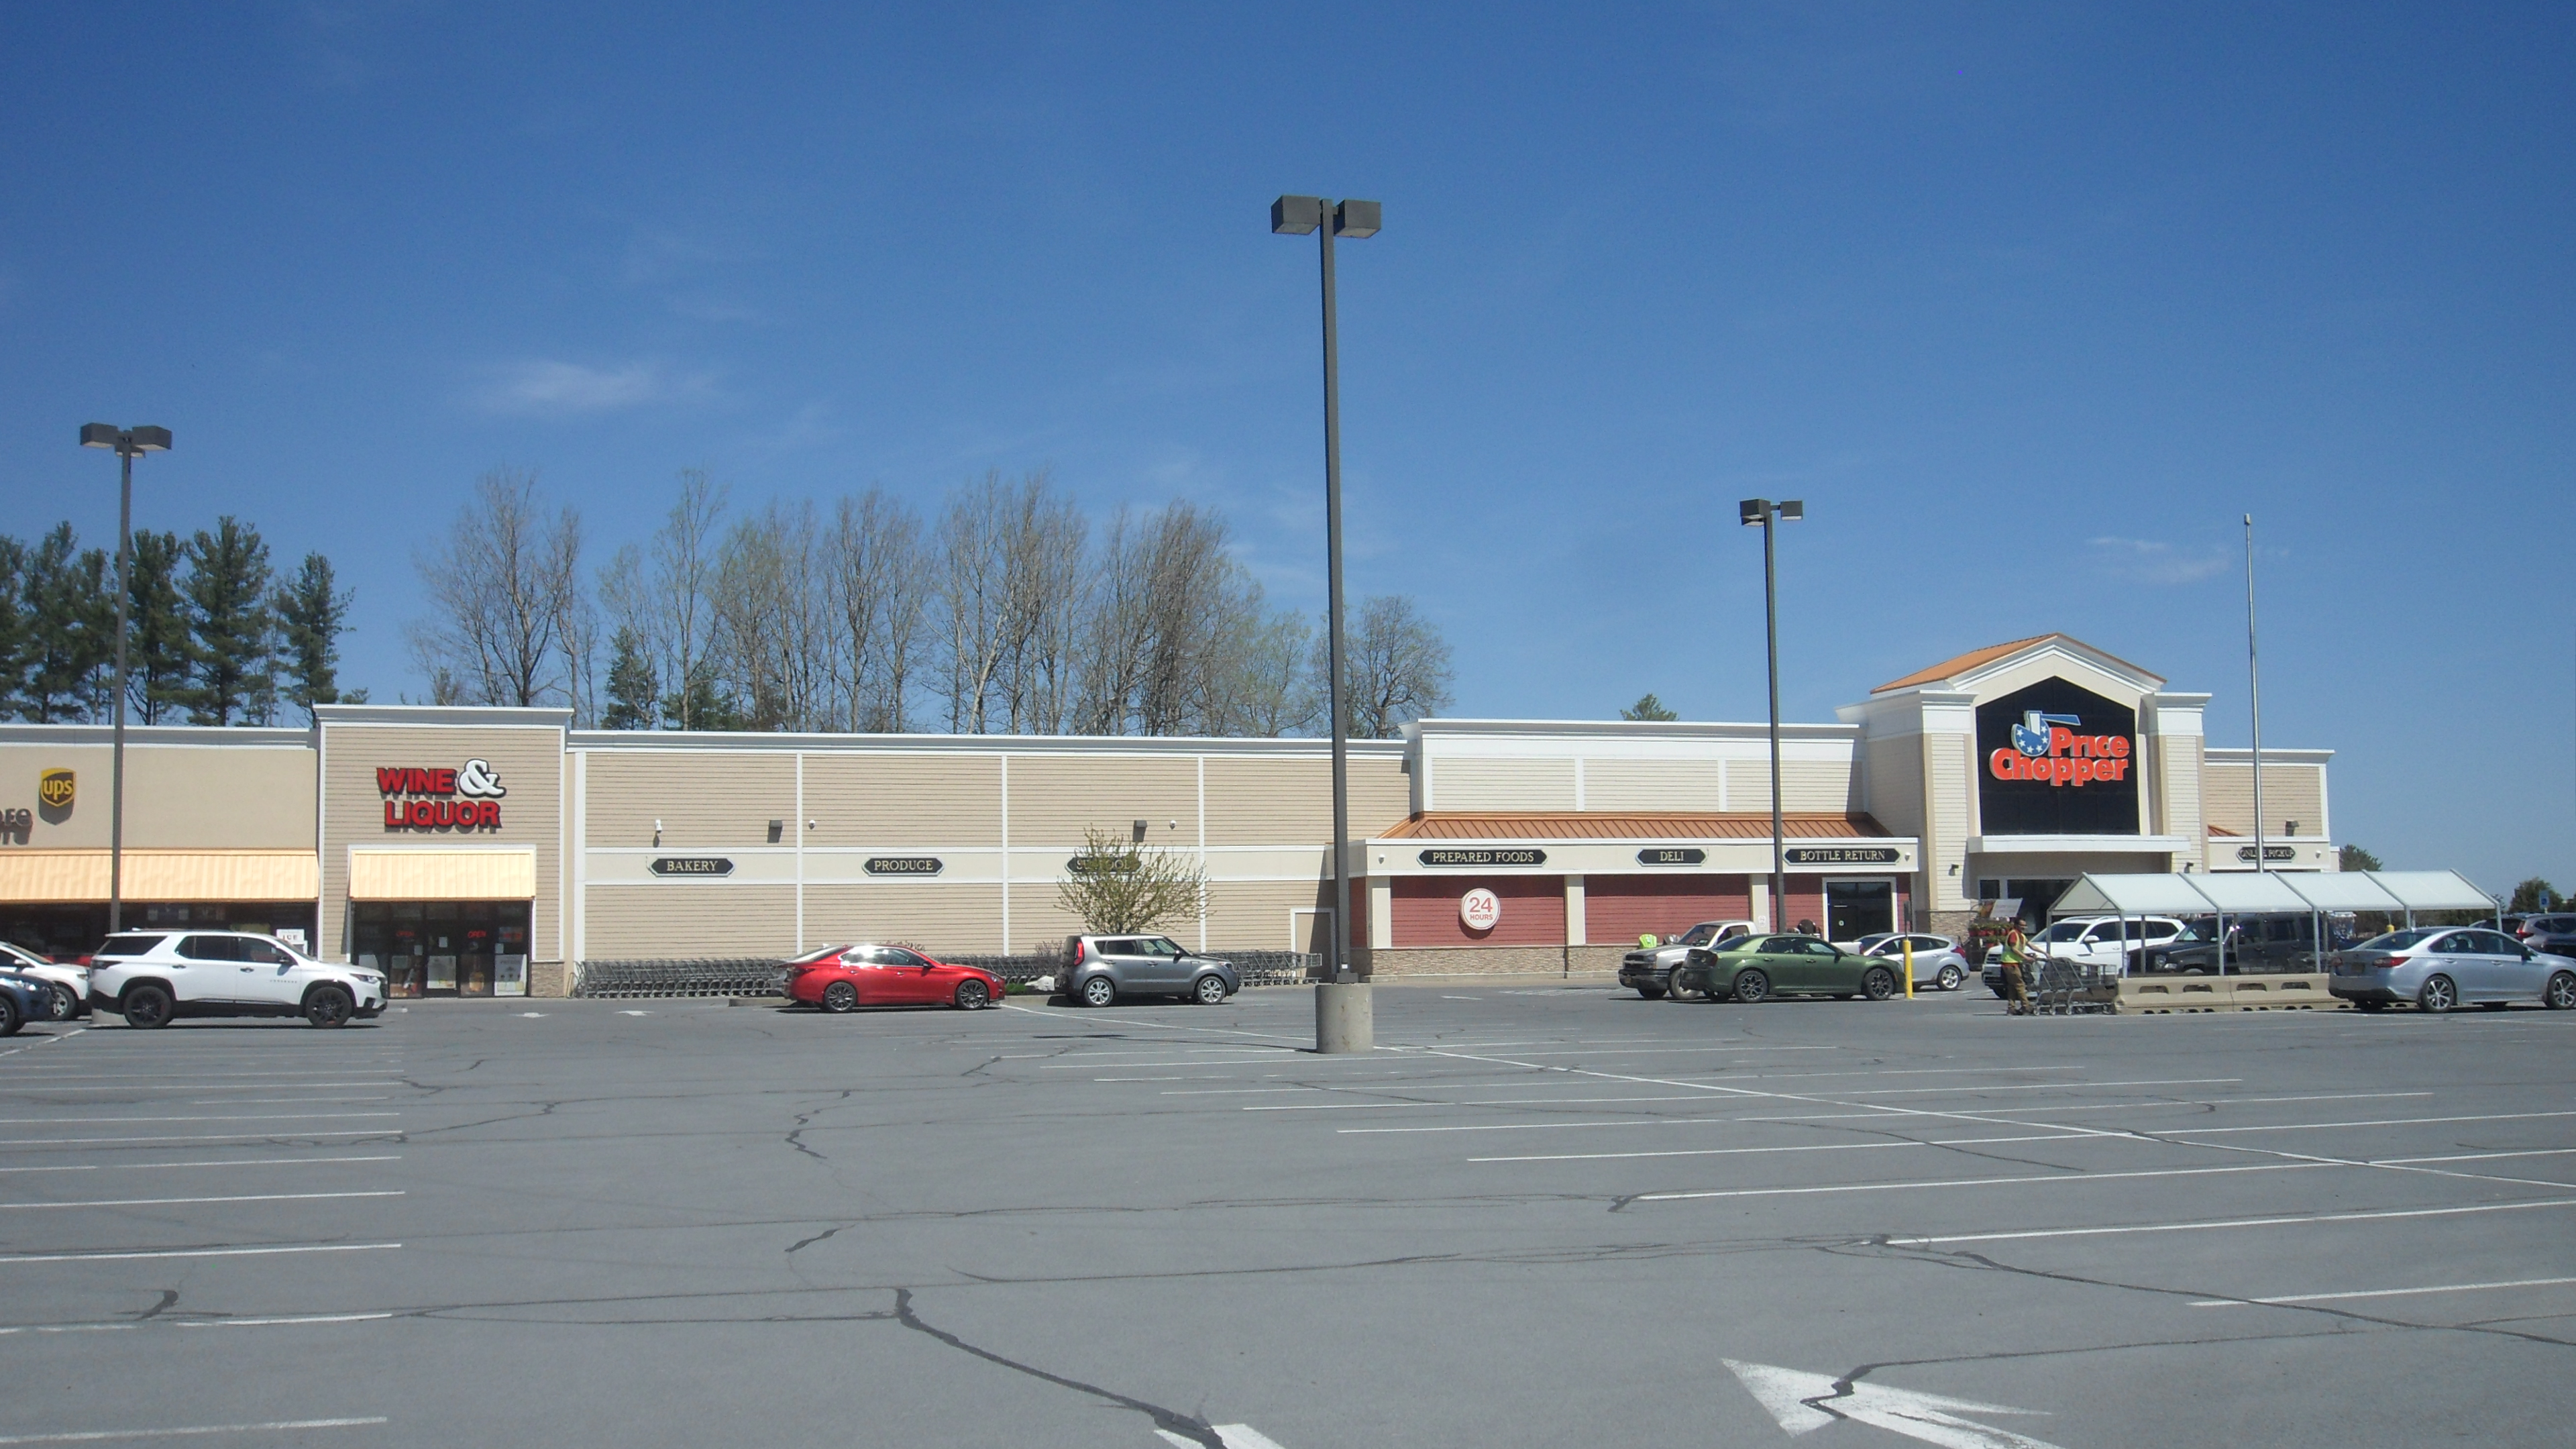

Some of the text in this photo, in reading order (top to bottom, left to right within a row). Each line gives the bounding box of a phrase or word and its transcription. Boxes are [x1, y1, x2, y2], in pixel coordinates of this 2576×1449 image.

[2048, 727, 2130, 757] Price
[1990, 747, 2129, 786] Chopper
[376, 758, 506, 798] WINE &
[43, 780, 74, 800] ups
[384, 800, 502, 828] LIQUOR
[1432, 851, 1534, 863] PREPARED FOODS
[1660, 851, 1684, 861] DELI
[1800, 850, 1885, 861] BOTTLE RETURN
[2268, 849, 2294, 857] PICKUP
[666, 861, 718, 871] BAKERY
[874, 860, 933, 871] PRODUCE
[1469, 897, 1493, 913] 24
